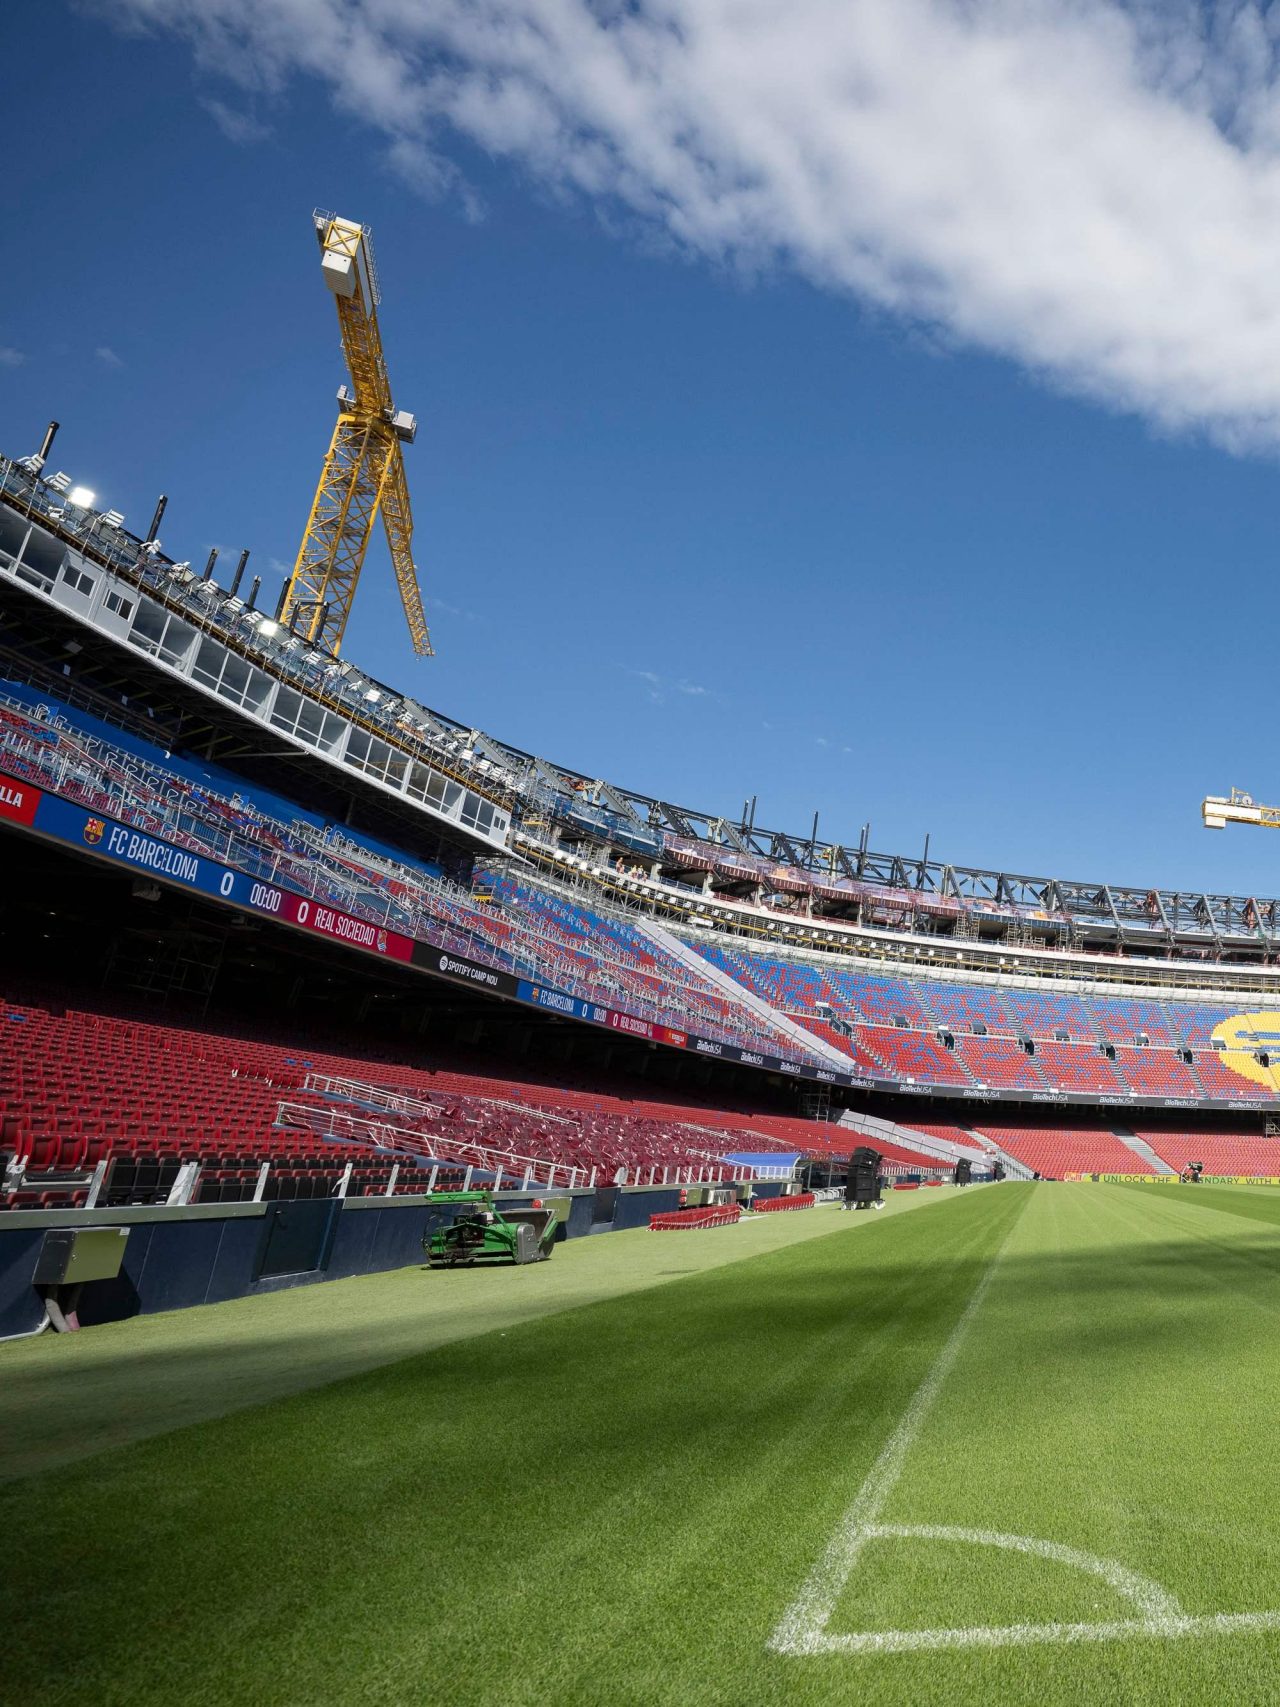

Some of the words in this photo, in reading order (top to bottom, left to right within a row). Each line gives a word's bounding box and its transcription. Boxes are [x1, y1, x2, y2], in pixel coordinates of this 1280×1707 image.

[108, 826, 128, 855] FC
[127, 835, 199, 882] BARCELONA
[220, 872, 234, 896] 0
[250, 883, 282, 912] 00:00
[297, 901, 309, 923] 0
[314, 907, 334, 932] REAL
[335, 916, 376, 946] SOCIEDAD
[447, 960, 471, 976] SPOTIFY
[470, 968, 487, 983] CAMP
[486, 974, 498, 986] NOU
[540, 990, 548, 1004] FC
[547, 991, 574, 1013] BARCELONA
[581, 1003, 588, 1017] 0
[612, 1013, 618, 1027] 0
[1103, 1175, 1146, 1183] UNLOCK
[1152, 1176, 1171, 1184] THE
[1245, 1177, 1272, 1185] WITH
